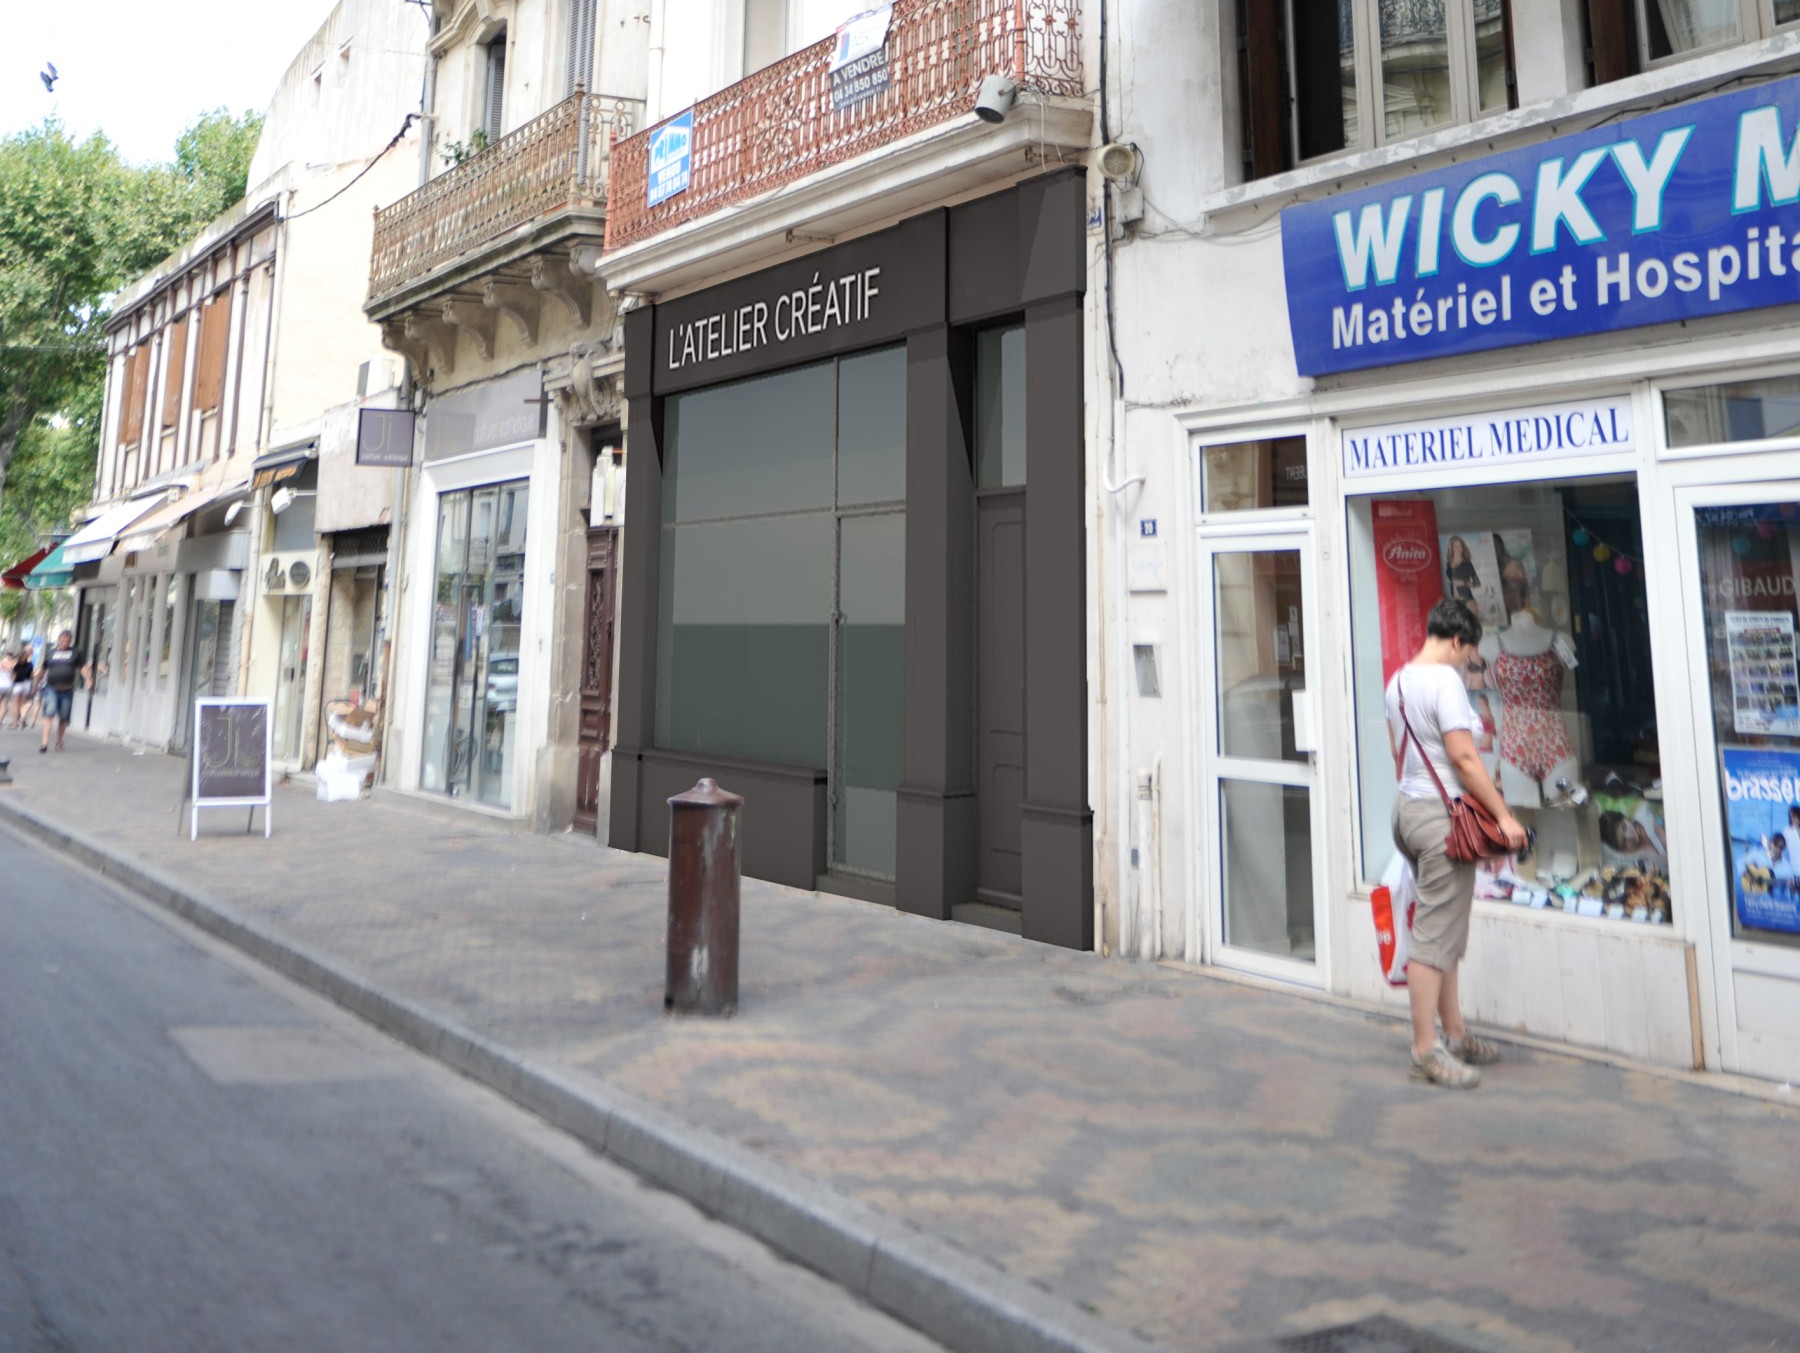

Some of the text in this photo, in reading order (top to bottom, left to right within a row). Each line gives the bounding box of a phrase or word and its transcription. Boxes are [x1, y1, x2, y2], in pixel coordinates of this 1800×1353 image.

[841, 50, 885, 81] VENDRE
[1332, 124, 1697, 292] WICKY
[669, 267, 880, 370] L'ATELIER CRÉATIF
[1332, 275, 1511, 349] Matériel
[1530, 265, 1577, 316] et
[1350, 408, 1629, 471] MATERIEL MEDICAL
[1388, 546, 1427, 560] Anita
[1719, 574, 1796, 598] GIBAUD
[1725, 768, 1800, 805] brasse
